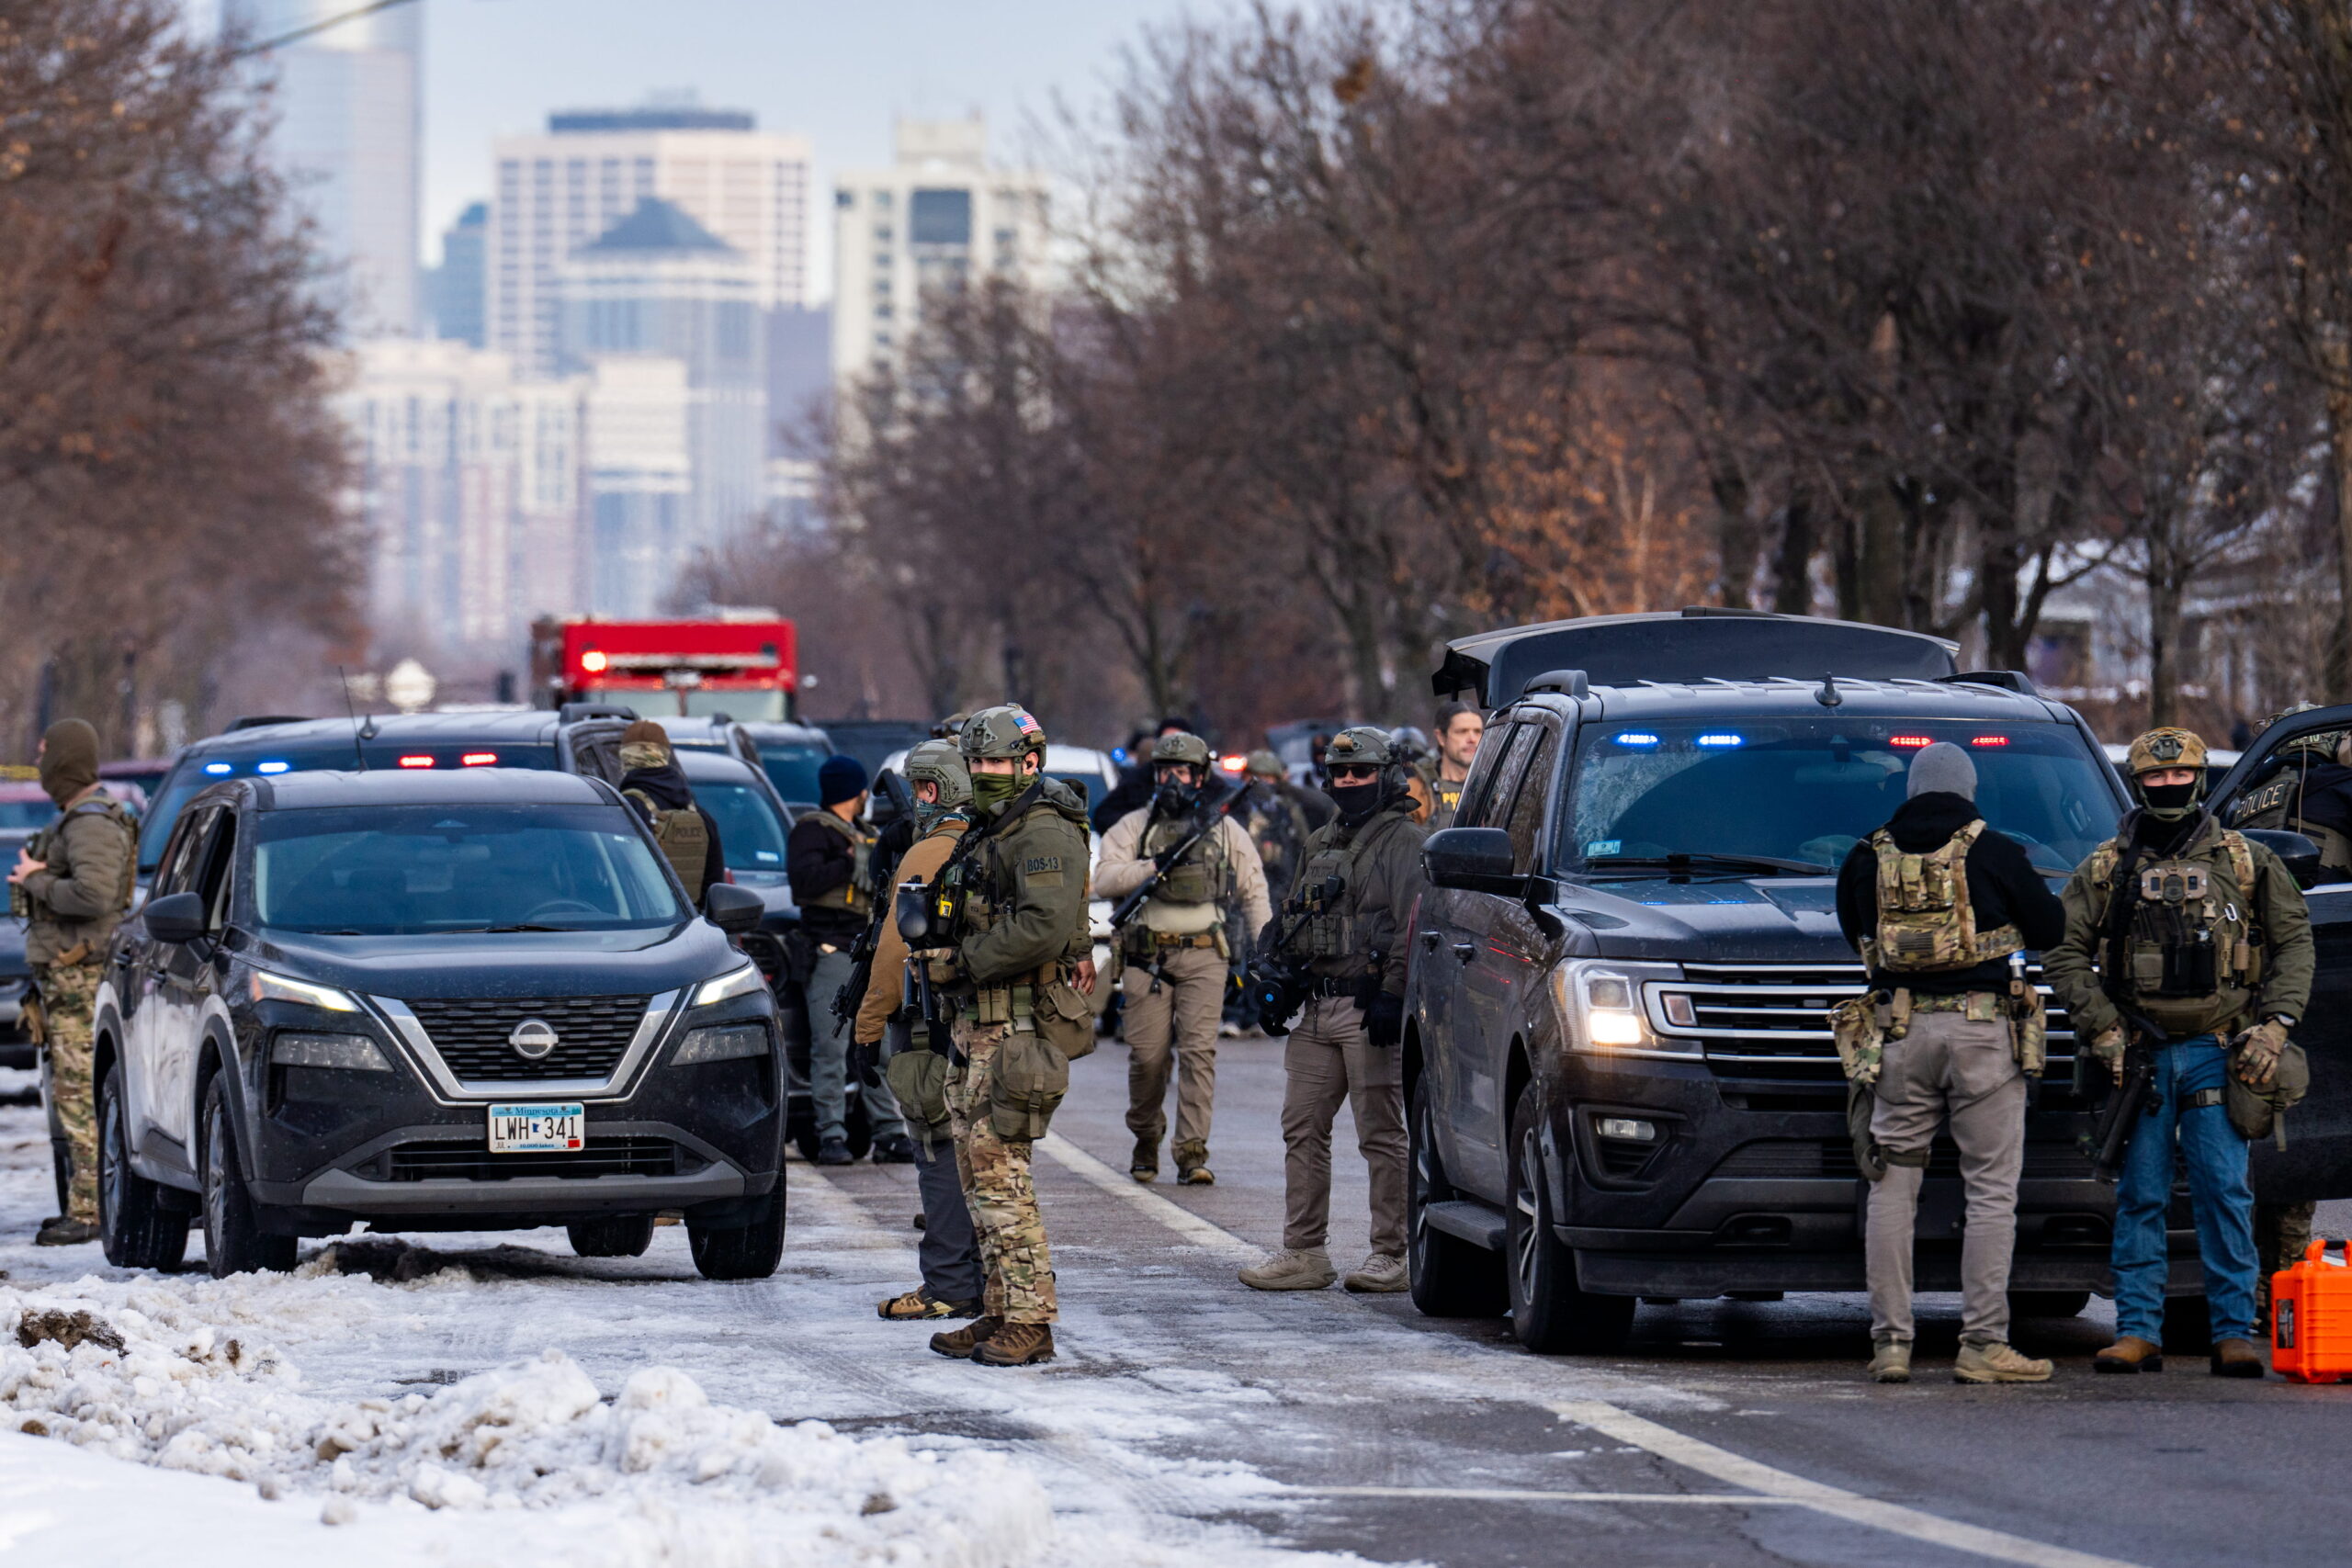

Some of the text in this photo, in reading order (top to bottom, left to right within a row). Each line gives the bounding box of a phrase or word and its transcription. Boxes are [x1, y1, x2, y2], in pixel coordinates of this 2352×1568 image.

[2233, 783, 2285, 823] POLICE
[1027, 857, 1059, 872] BOS-13
[515, 1106, 559, 1115] Minnesota
[495, 1116, 578, 1140] LWH 341
